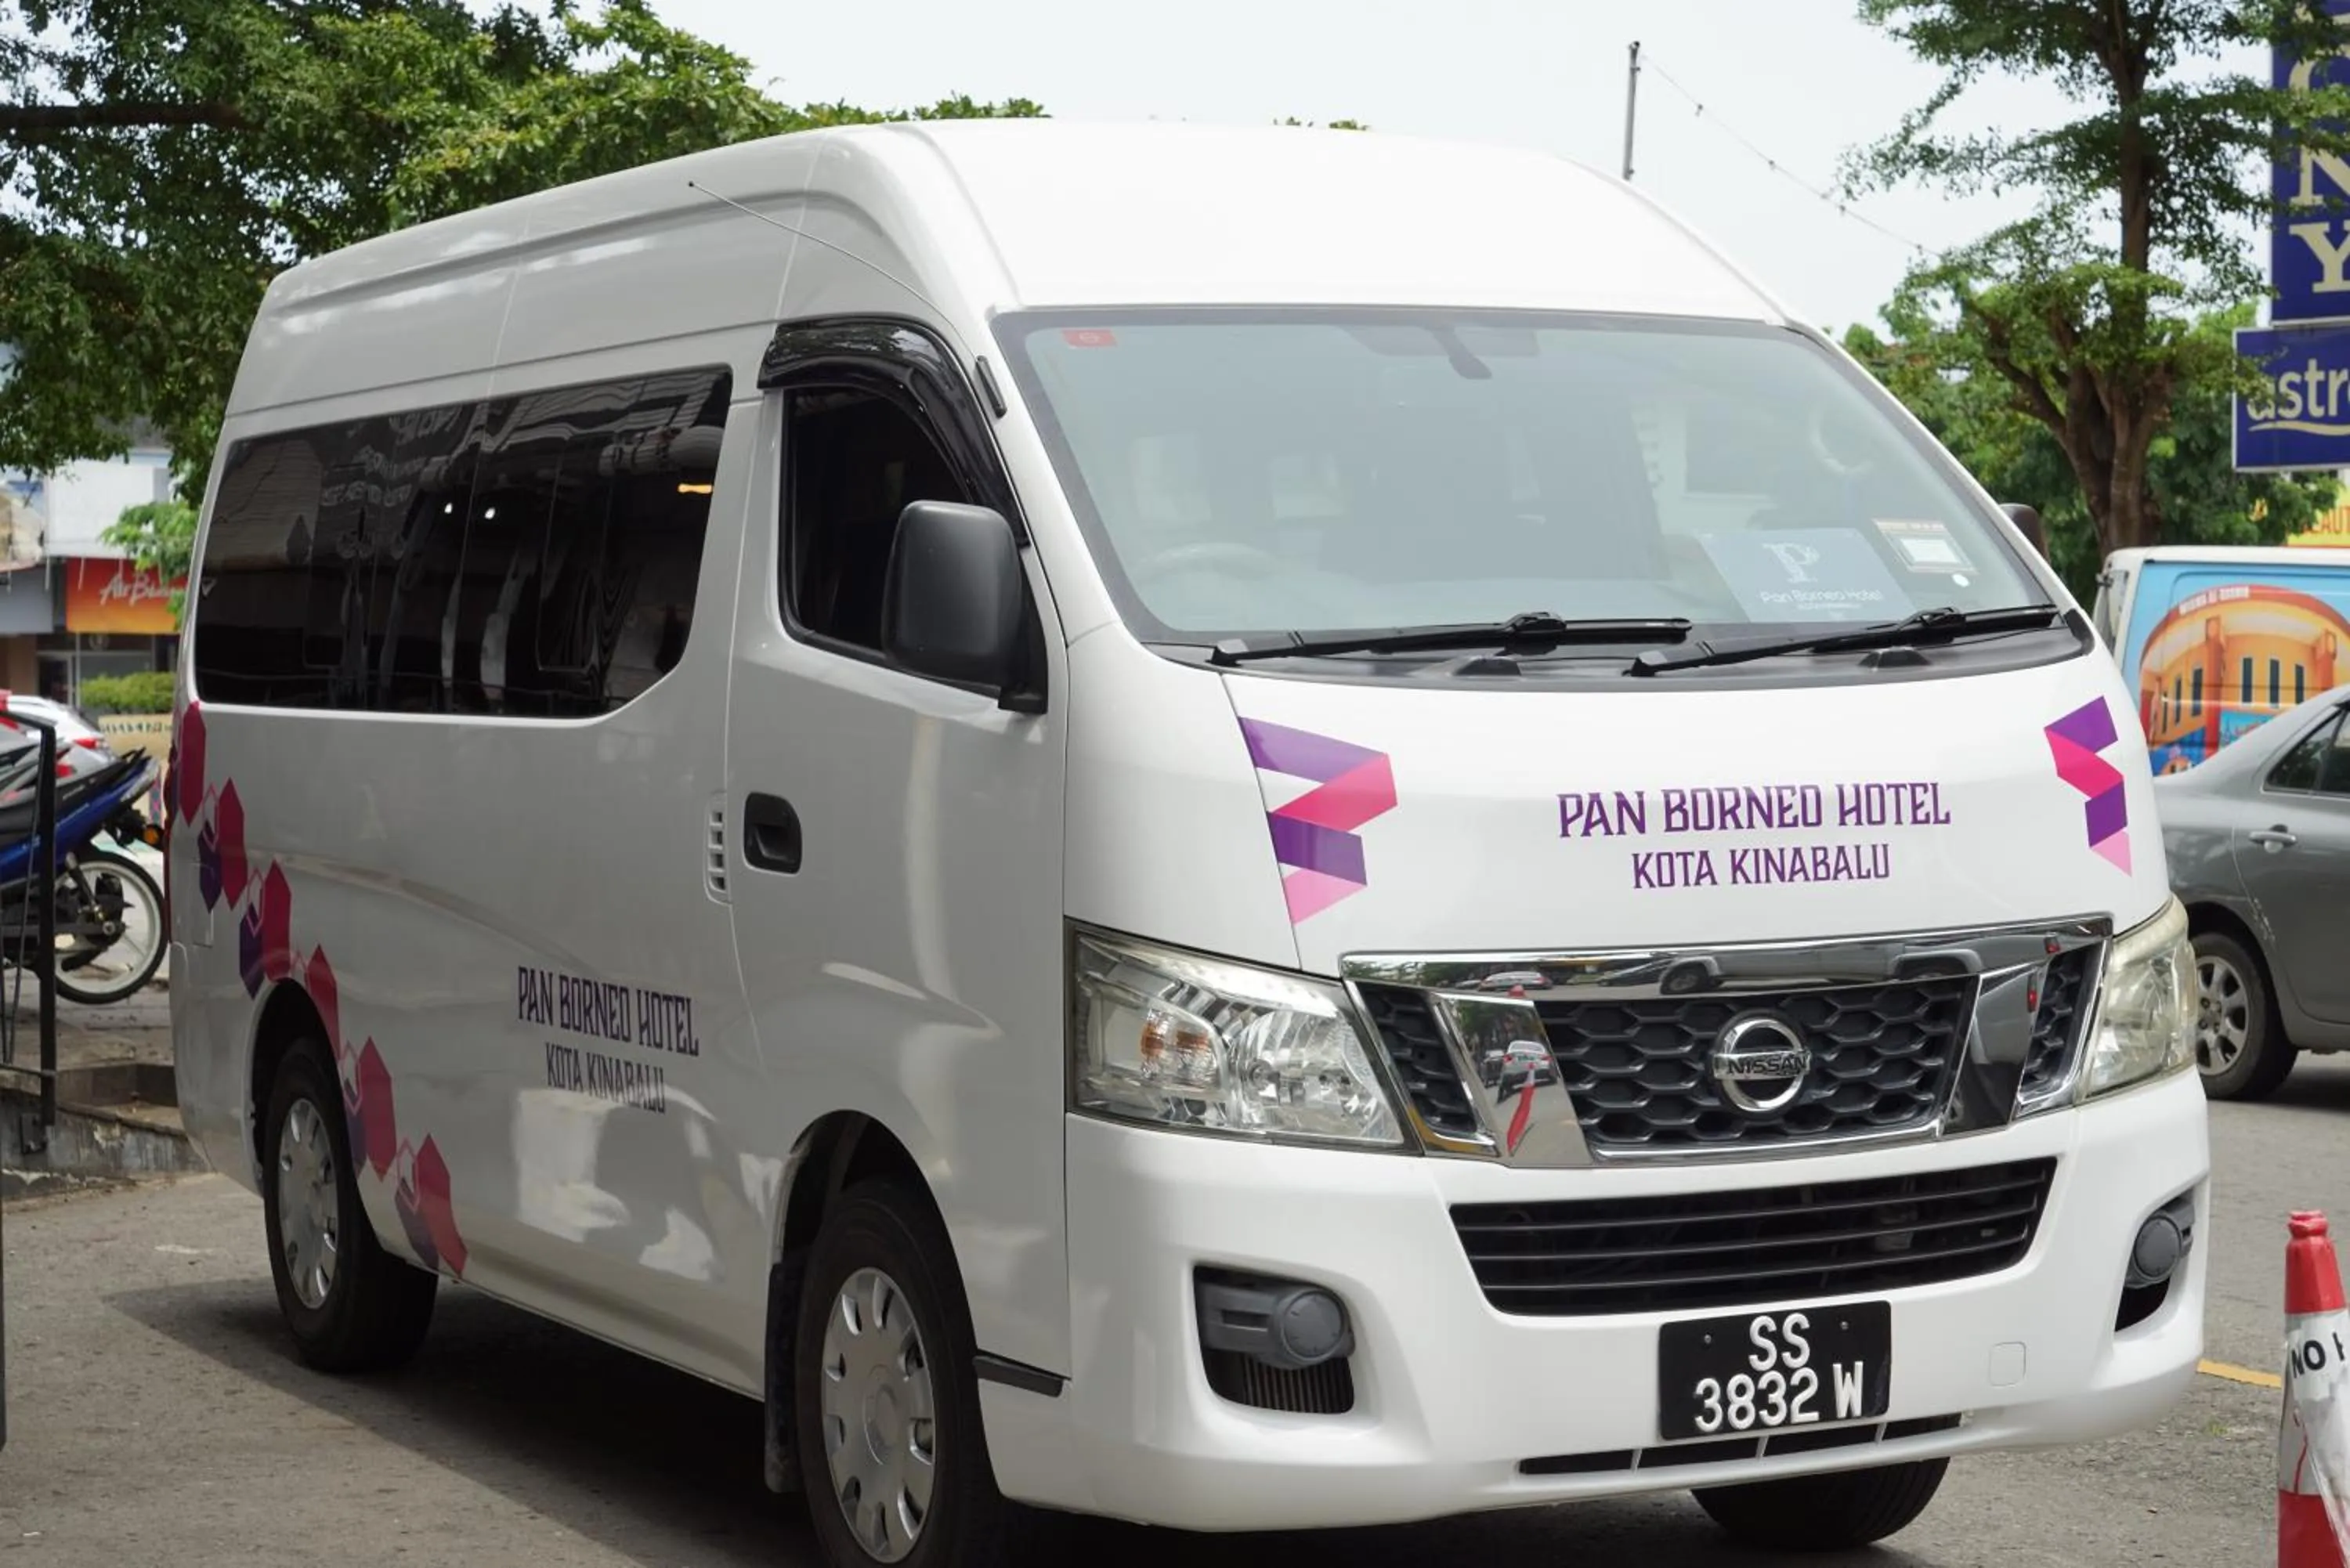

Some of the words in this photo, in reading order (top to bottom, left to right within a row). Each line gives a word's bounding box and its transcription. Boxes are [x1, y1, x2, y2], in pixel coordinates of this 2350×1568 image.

[2247, 358, 2350, 421] astr
[1557, 791, 1646, 837] PAN
[1661, 786, 1823, 832] BORNEO
[1836, 782, 1950, 826] HOTEL
[1632, 851, 1717, 888] KOTA
[1729, 844, 1889, 885] KINABALU
[518, 965, 554, 1026] PAN
[559, 974, 631, 1043] BORNEO
[636, 988, 700, 1057] HOTEL
[545, 1042, 584, 1093] KOTA
[586, 1051, 665, 1114] KINABALU
[1726, 1053, 1806, 1076] NISSAN
[1748, 1313, 1810, 1371] SS
[2290, 1339, 2326, 1379] NO
[1694, 1367, 1820, 1433] 3832
[1832, 1360, 1864, 1418] W
